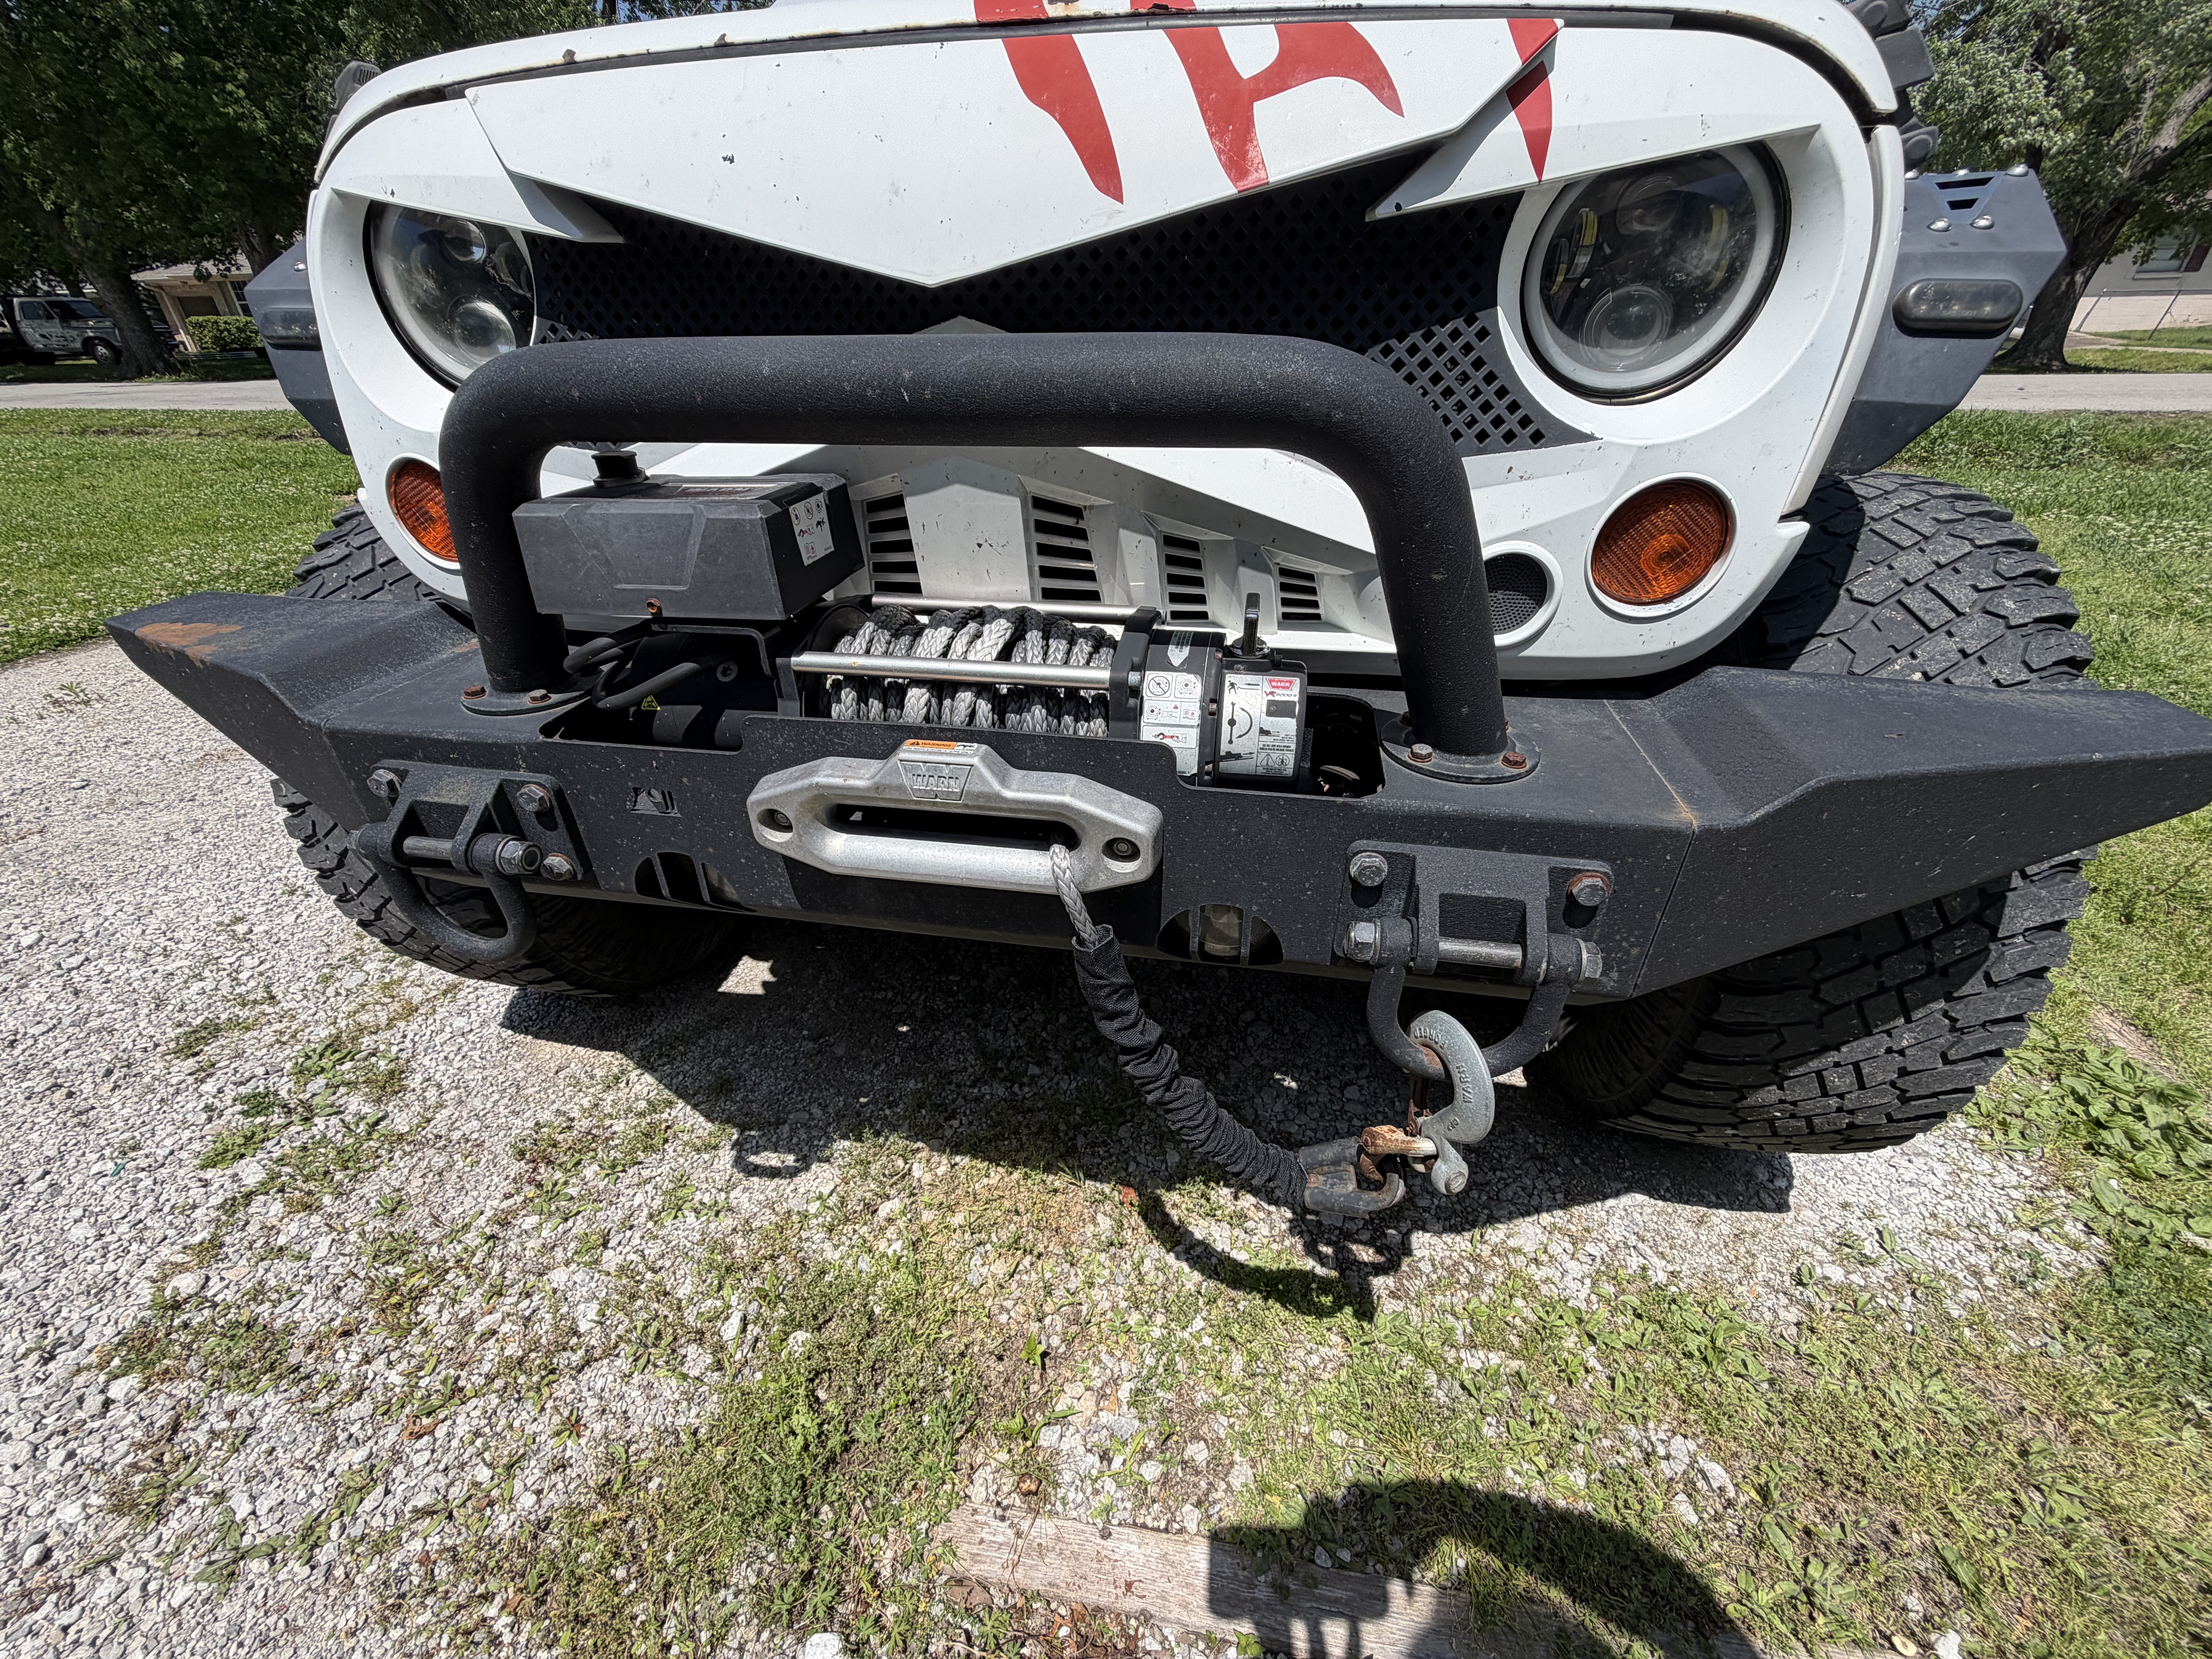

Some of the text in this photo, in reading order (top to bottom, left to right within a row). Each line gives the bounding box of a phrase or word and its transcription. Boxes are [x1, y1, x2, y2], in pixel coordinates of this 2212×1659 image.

[912, 773, 959, 792] WARN
[1413, 1027, 1448, 1050] FORGED
[1456, 1063, 1474, 1104] WARN
